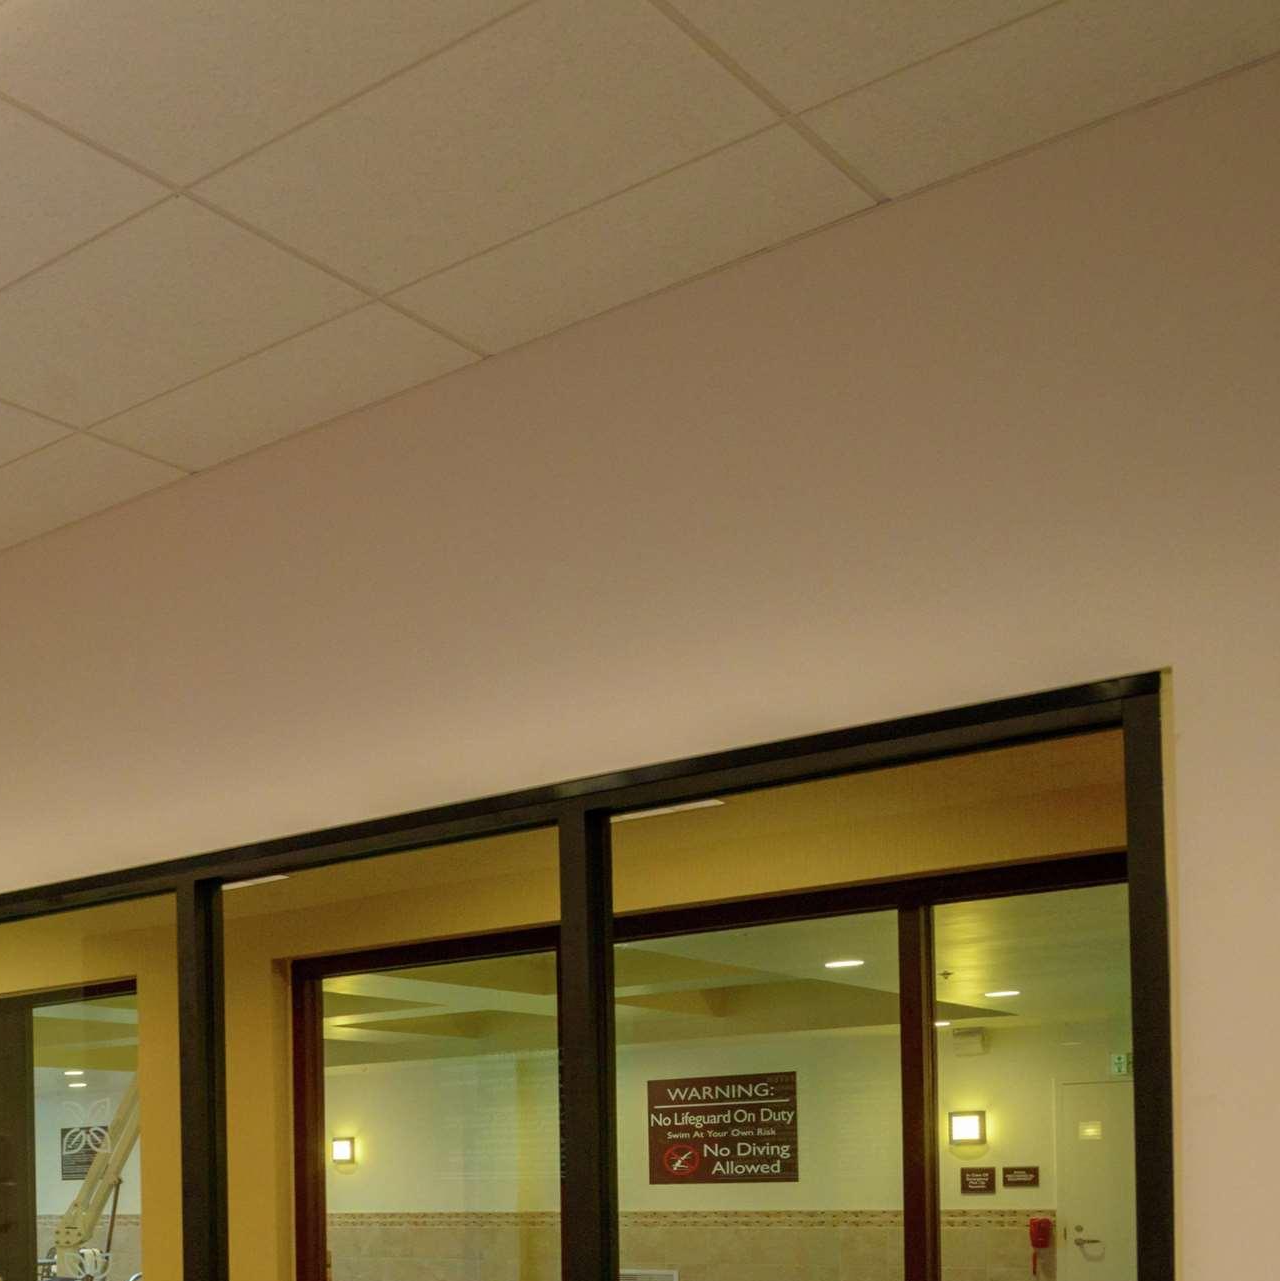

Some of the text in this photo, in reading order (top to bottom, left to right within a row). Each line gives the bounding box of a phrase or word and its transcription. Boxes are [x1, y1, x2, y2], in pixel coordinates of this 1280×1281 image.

[667, 1083, 775, 1101] WARNING:
[650, 1108, 795, 1129] No Lifeguard On Duty
[667, 1127, 777, 1140] Swim At Your Own Risk
[703, 1142, 791, 1159] No Diving
[711, 1160, 781, 1175] Allowed
